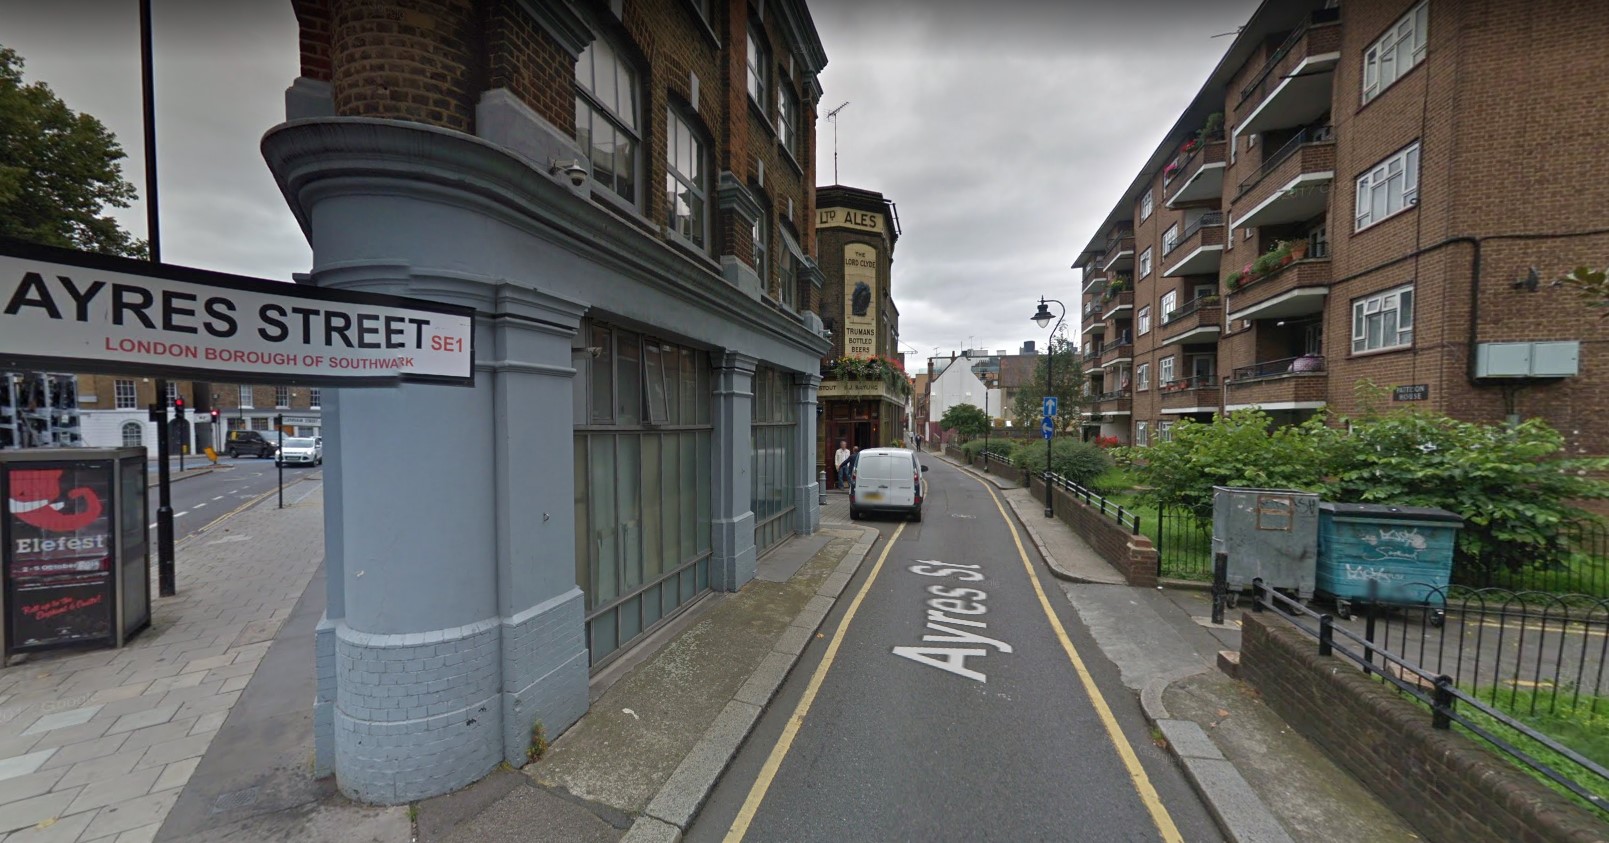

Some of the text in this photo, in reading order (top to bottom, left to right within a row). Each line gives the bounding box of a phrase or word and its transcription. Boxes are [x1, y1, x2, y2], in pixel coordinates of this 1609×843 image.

[844, 211, 877, 228] ALES
[845, 258, 876, 269] LORD CLYDE
[4, 271, 464, 353] AYRES STREET SE1
[846, 327, 875, 336] TRUMANS
[848, 337, 873, 345] BOTTLED
[105, 336, 414, 371] LONDON BOROUGH OF SOUTHWARK
[17, 535, 104, 553] Elefest
